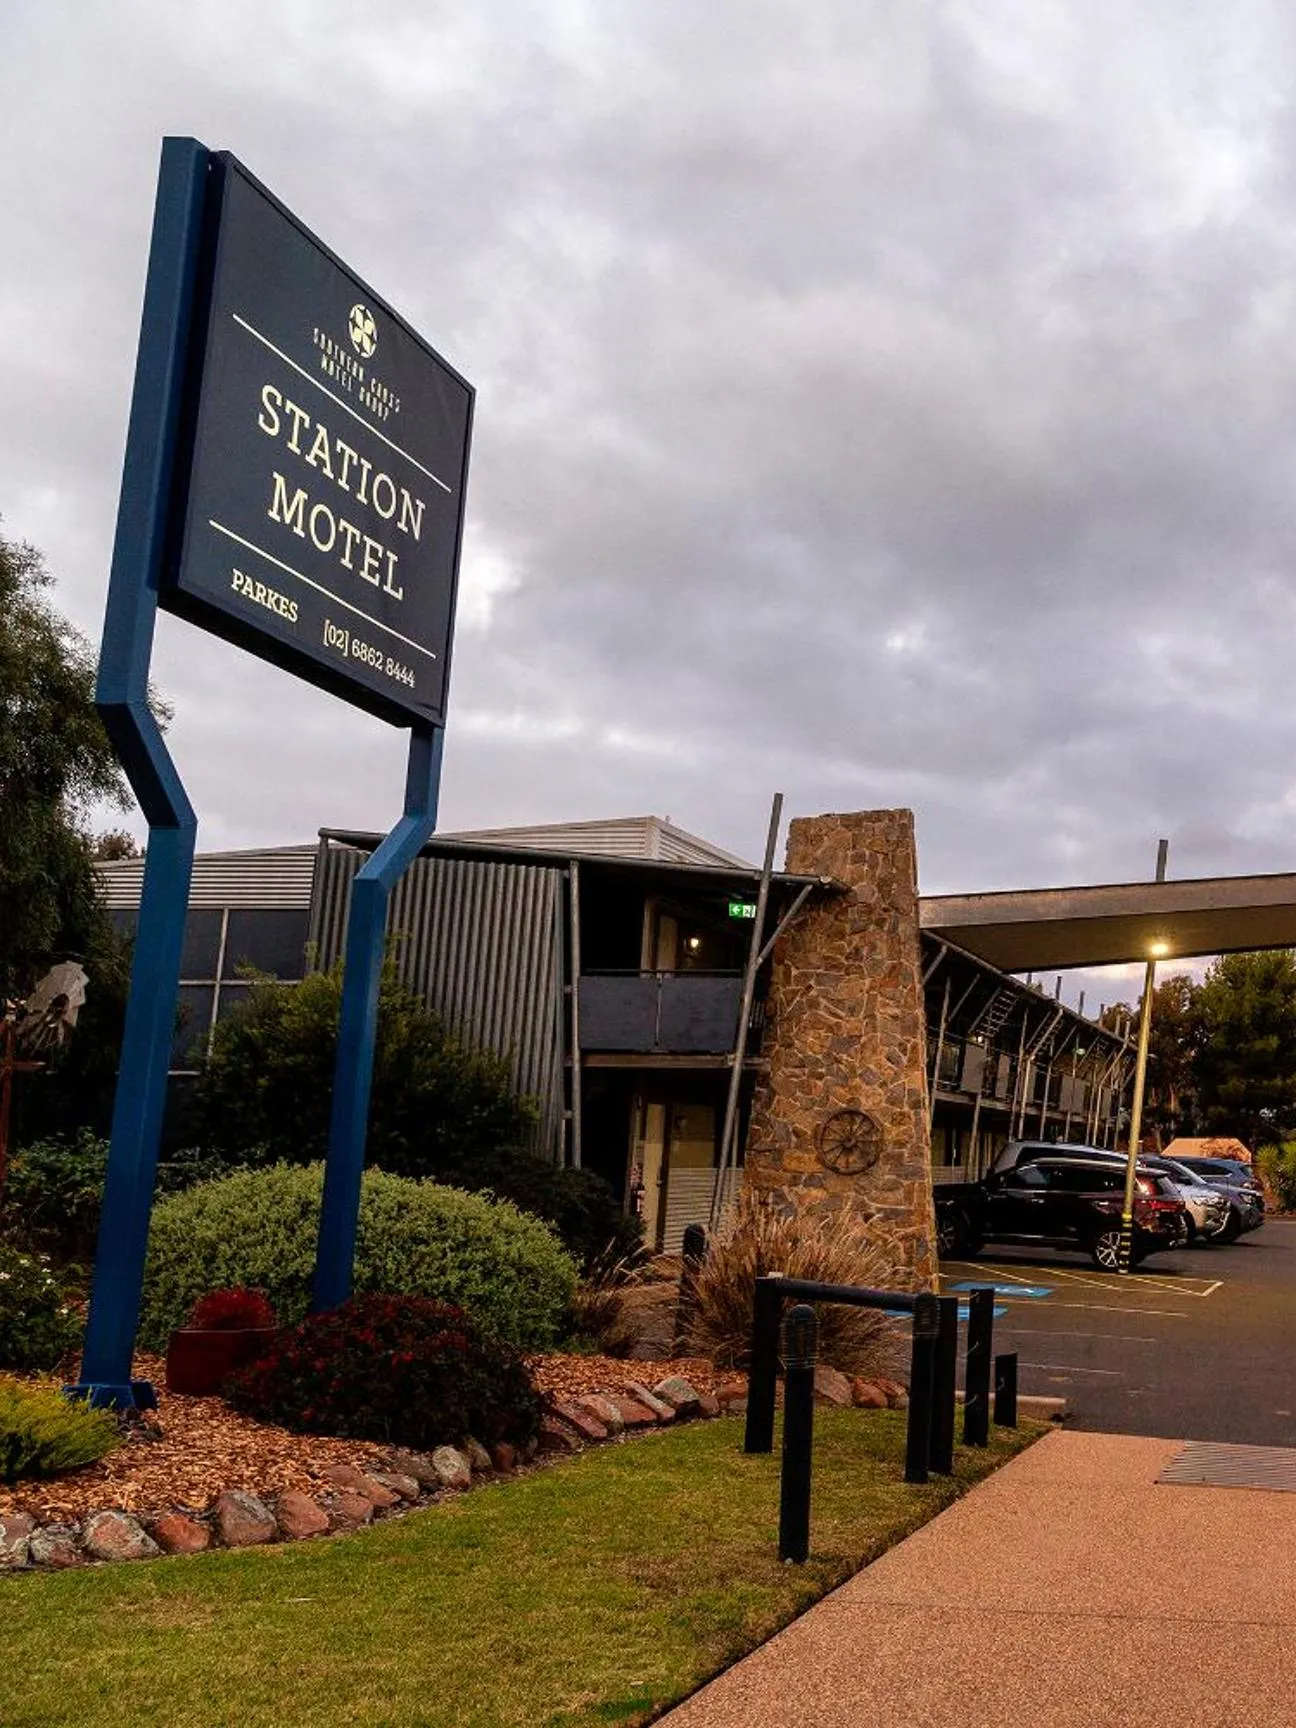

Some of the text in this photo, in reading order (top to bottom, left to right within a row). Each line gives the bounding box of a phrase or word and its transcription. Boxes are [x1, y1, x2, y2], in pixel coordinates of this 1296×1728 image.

[258, 384, 426, 542] STATION
[267, 471, 404, 601] MOTEL
[231, 568, 299, 624] PARKES
[323, 618, 416, 689] [02] 6862 8444
